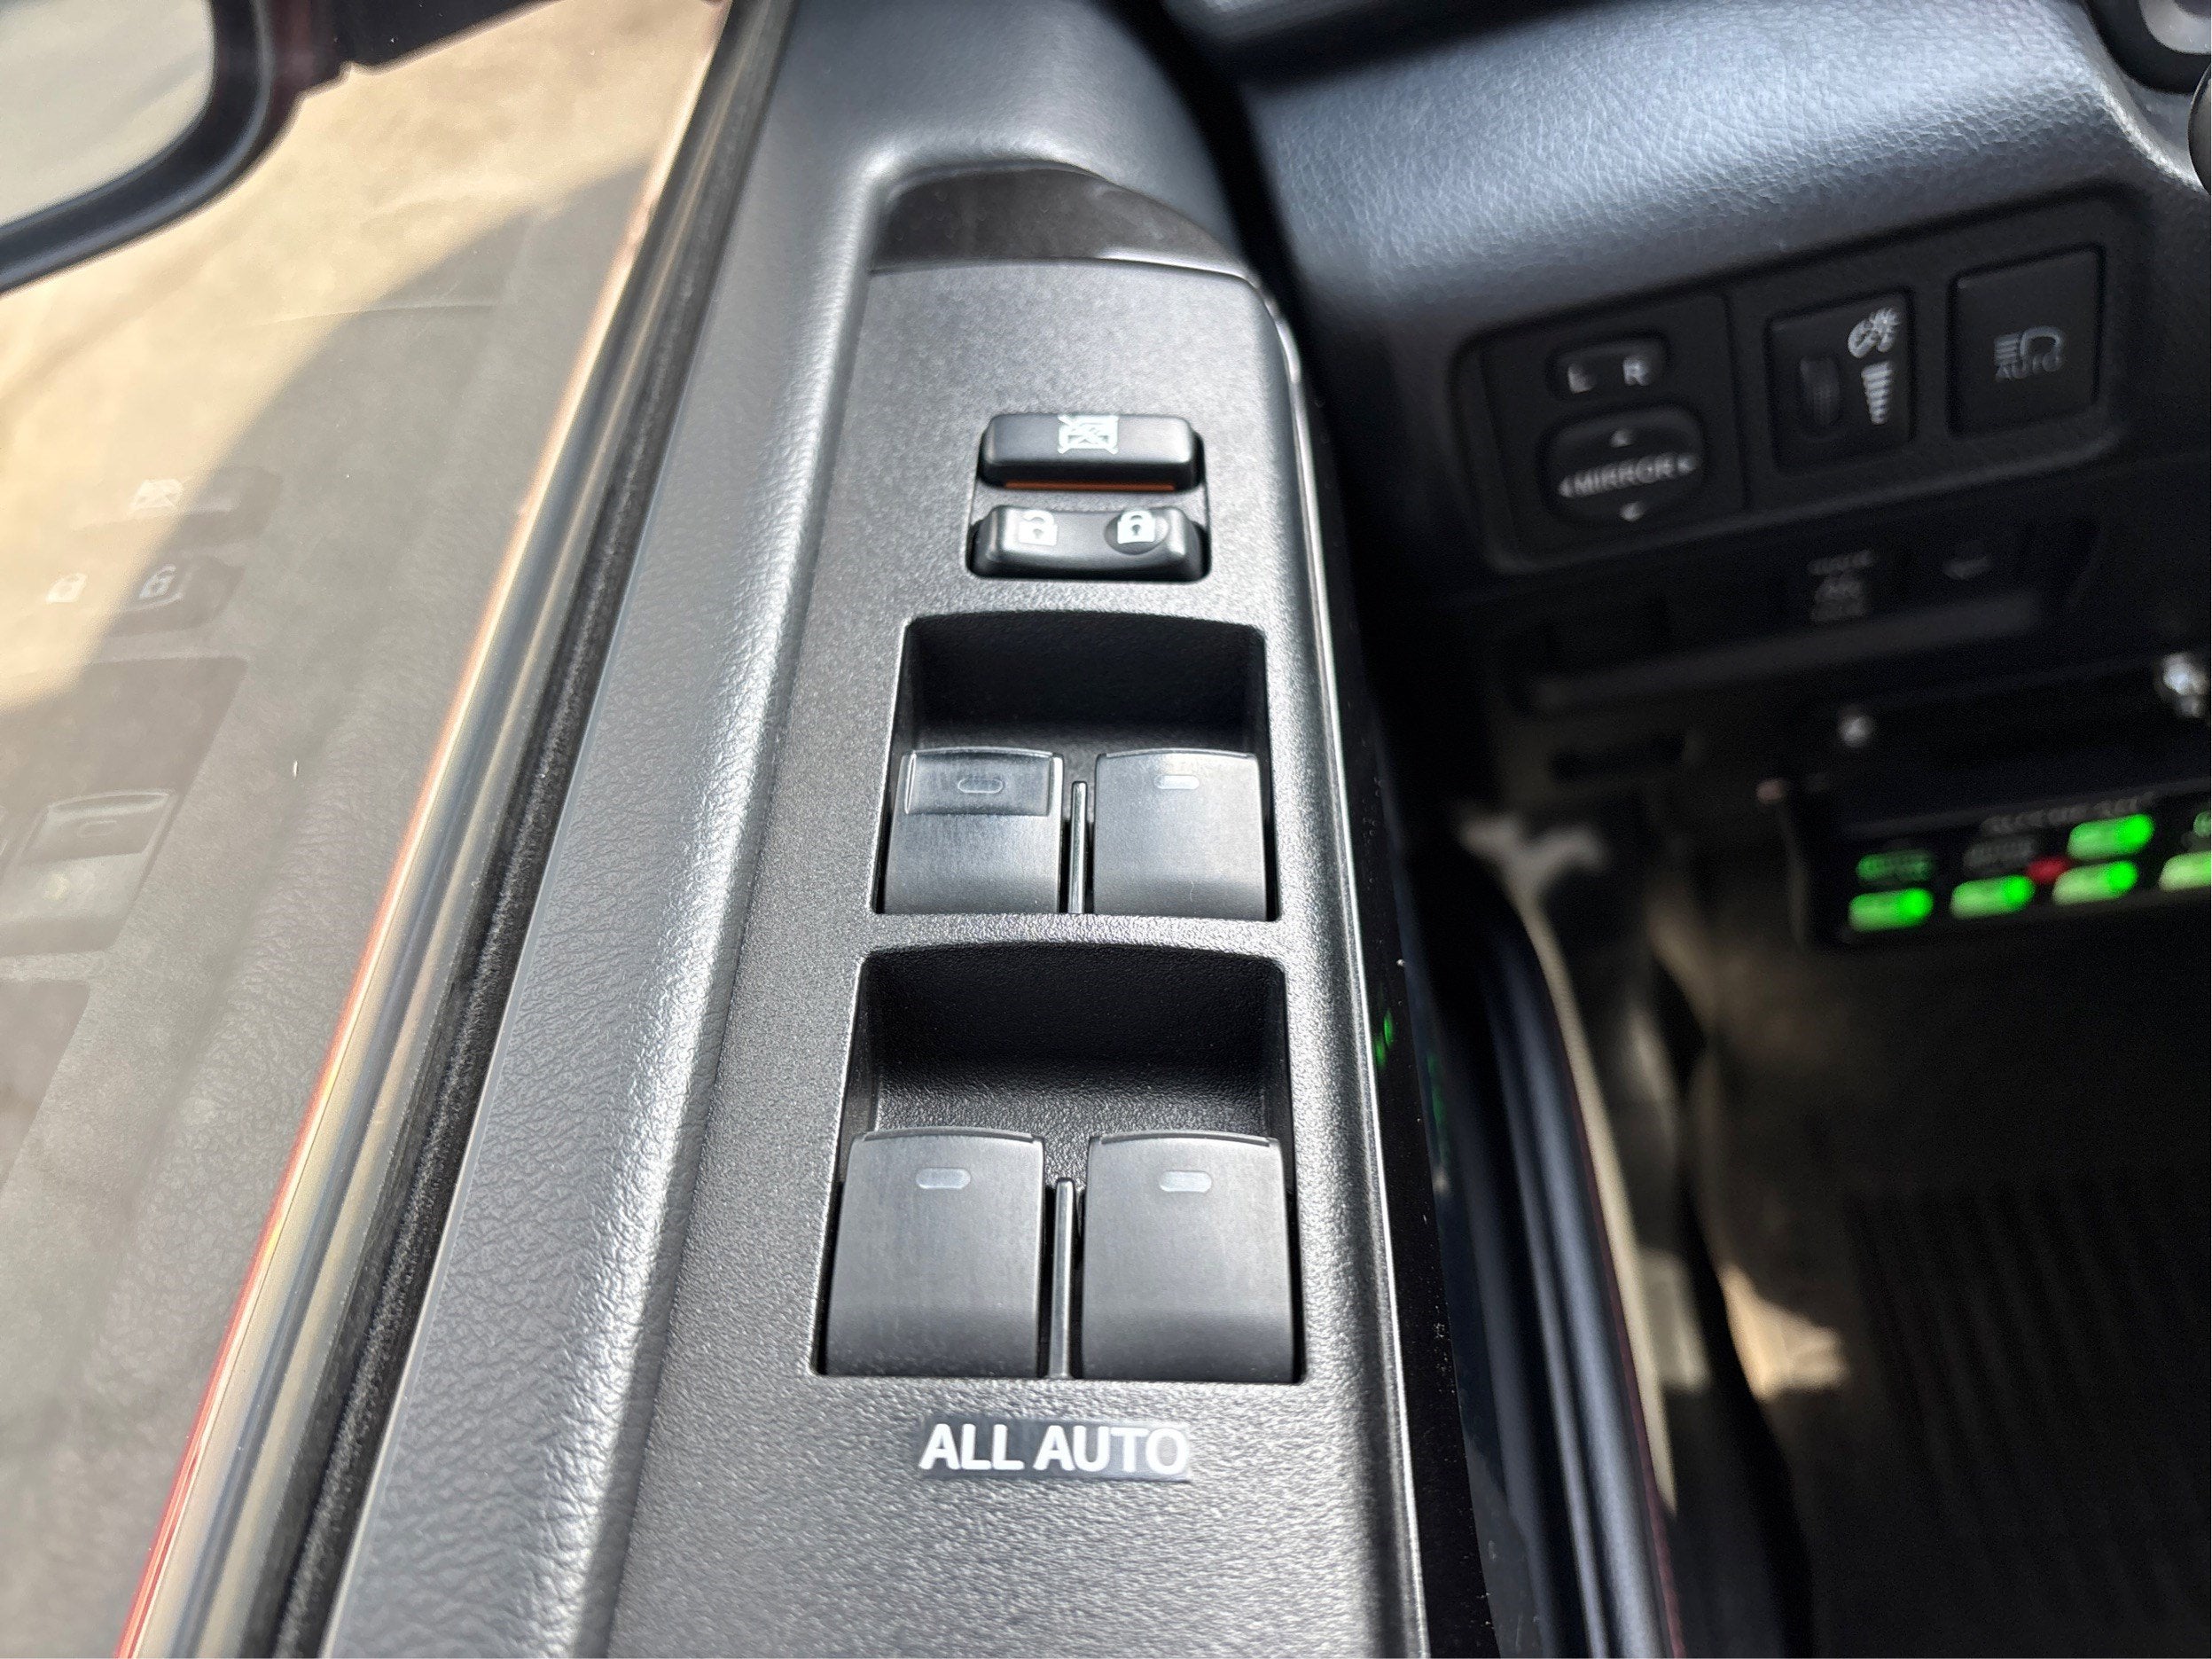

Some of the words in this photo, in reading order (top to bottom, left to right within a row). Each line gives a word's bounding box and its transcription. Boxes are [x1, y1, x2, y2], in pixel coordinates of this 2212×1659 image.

[1567, 364, 1595, 394] L
[1622, 355, 1650, 387] R
[1995, 353, 2064, 380] AUTO
[1573, 453, 1677, 498] MIRROR
[918, 1423, 1024, 1470] ALL
[1033, 1424, 1189, 1475] AUTO
